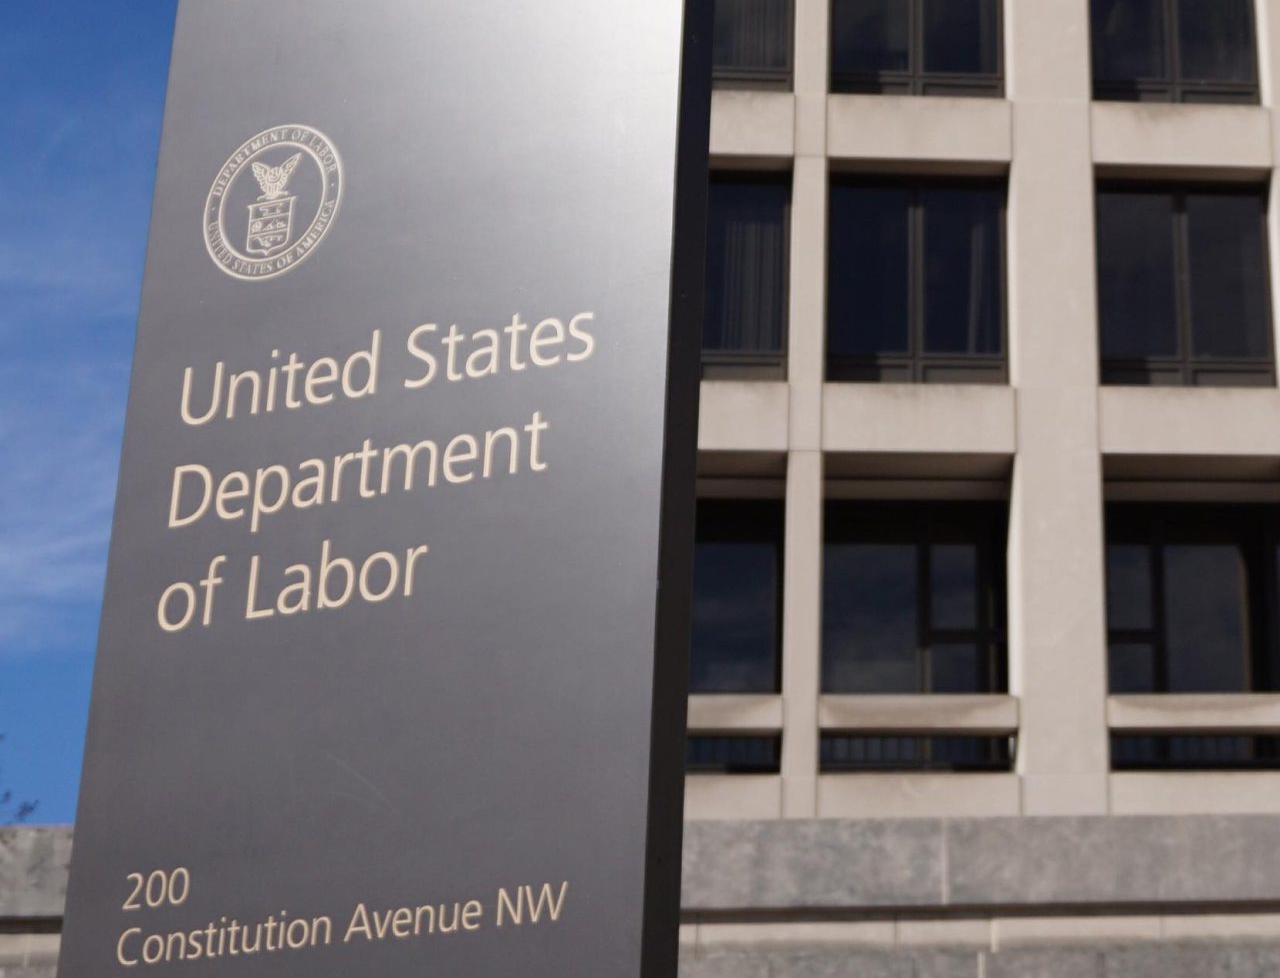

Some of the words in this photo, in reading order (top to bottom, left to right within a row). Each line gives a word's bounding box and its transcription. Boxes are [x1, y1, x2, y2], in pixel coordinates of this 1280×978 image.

[212, 129, 289, 197] DEPARTMENT
[291, 129, 309, 142] OF
[308, 135, 338, 173] LABOR
[207, 221, 233, 264] UNITED
[231, 259, 273, 275] STATES
[276, 253, 295, 269] OF
[297, 199, 336, 257] AMERICA
[180, 329, 380, 426] United
[404, 312, 594, 389] States
[168, 411, 548, 533] Department
[157, 555, 226, 632] of
[246, 540, 429, 619] Labor
[116, 910, 332, 966] Constitution
[343, 902, 482, 942] Avenue
[497, 881, 568, 926] NW
[121, 867, 190, 910] 200
